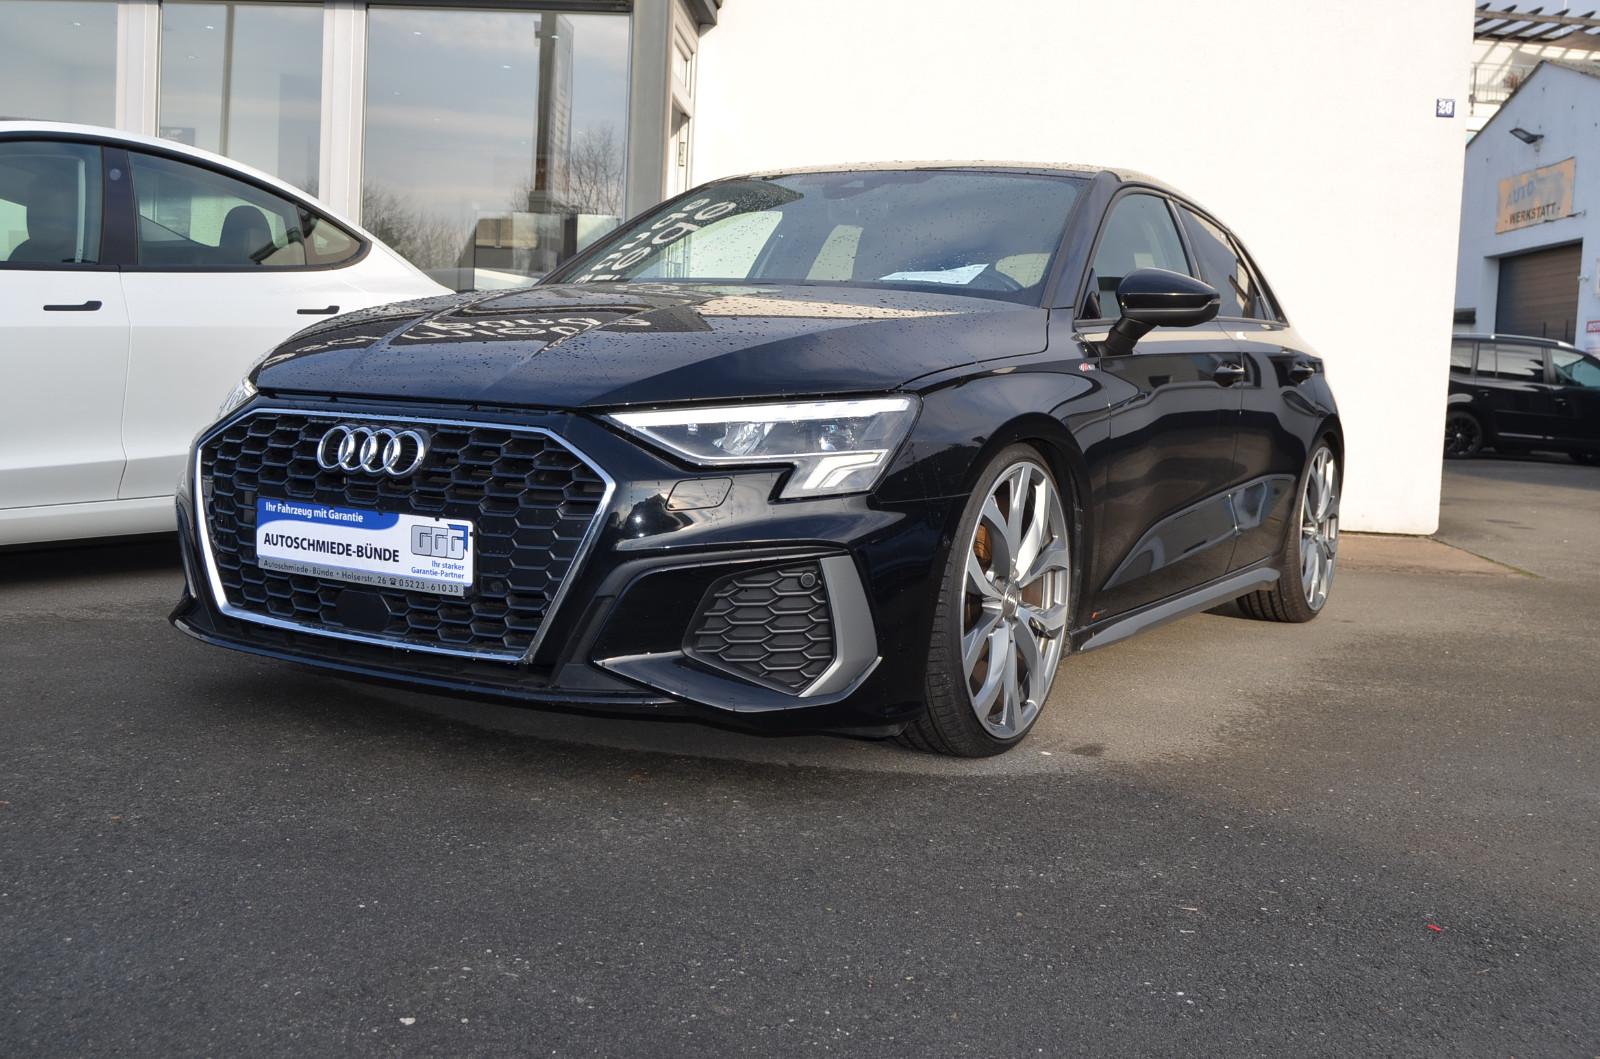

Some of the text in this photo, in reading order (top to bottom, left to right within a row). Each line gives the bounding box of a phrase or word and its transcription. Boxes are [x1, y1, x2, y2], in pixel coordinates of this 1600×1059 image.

[1509, 202, 1556, 224] WERKSTATT
[265, 502, 364, 523] Ihr Fahrzeug mit Garantie
[263, 533, 400, 562] AUTOSCHMIEDE-BÜNDE
[411, 566, 465, 579] Garantie-Partner
[432, 560, 465, 571] Ihr starker
[377, 575, 387, 585] 26
